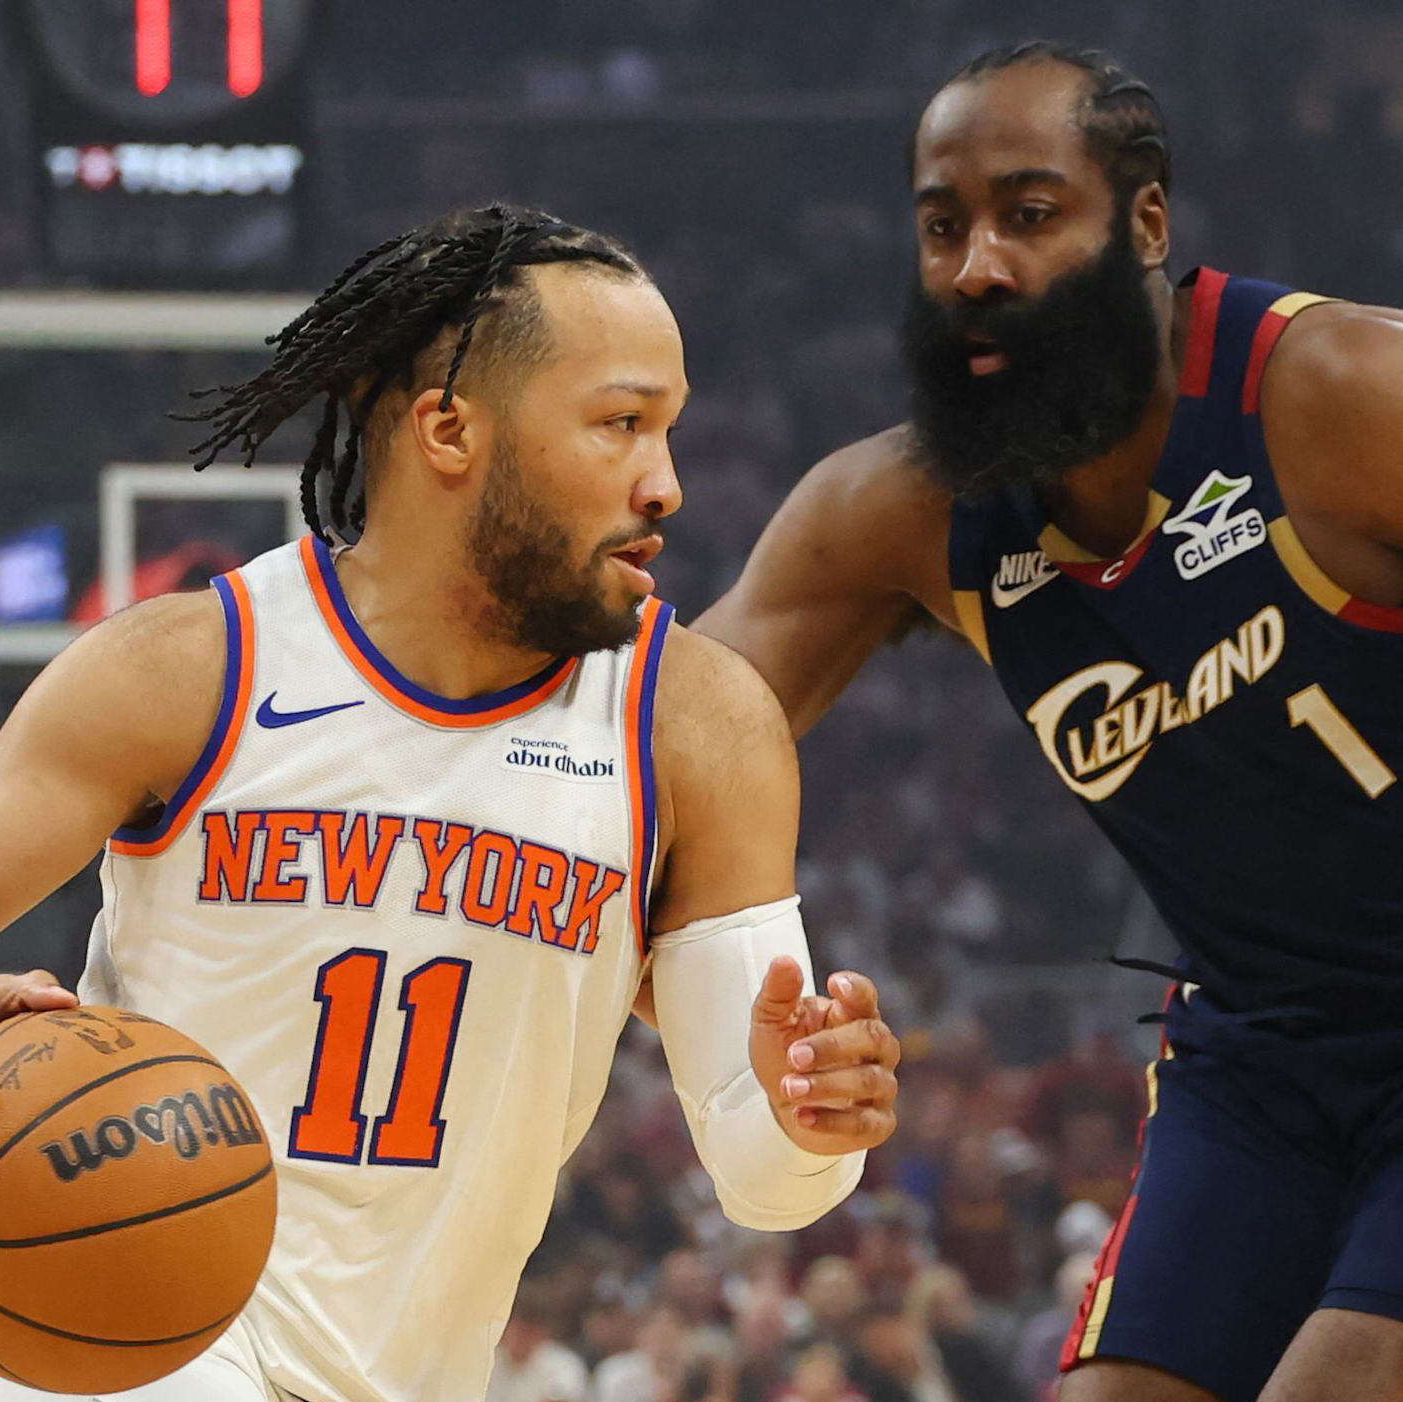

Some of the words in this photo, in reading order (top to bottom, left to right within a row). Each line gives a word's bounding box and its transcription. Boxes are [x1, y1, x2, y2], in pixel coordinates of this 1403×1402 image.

[1181, 516, 1263, 571] CLIFFS
[505, 749, 551, 768] abu
[554, 755, 615, 776] dhabi
[510, 737, 569, 752] experience
[1286, 682, 1398, 800] 1
[197, 808, 406, 912] NEW
[401, 814, 629, 956] YORK
[288, 947, 472, 1168] 11
[41, 1082, 262, 1183] Wilson
